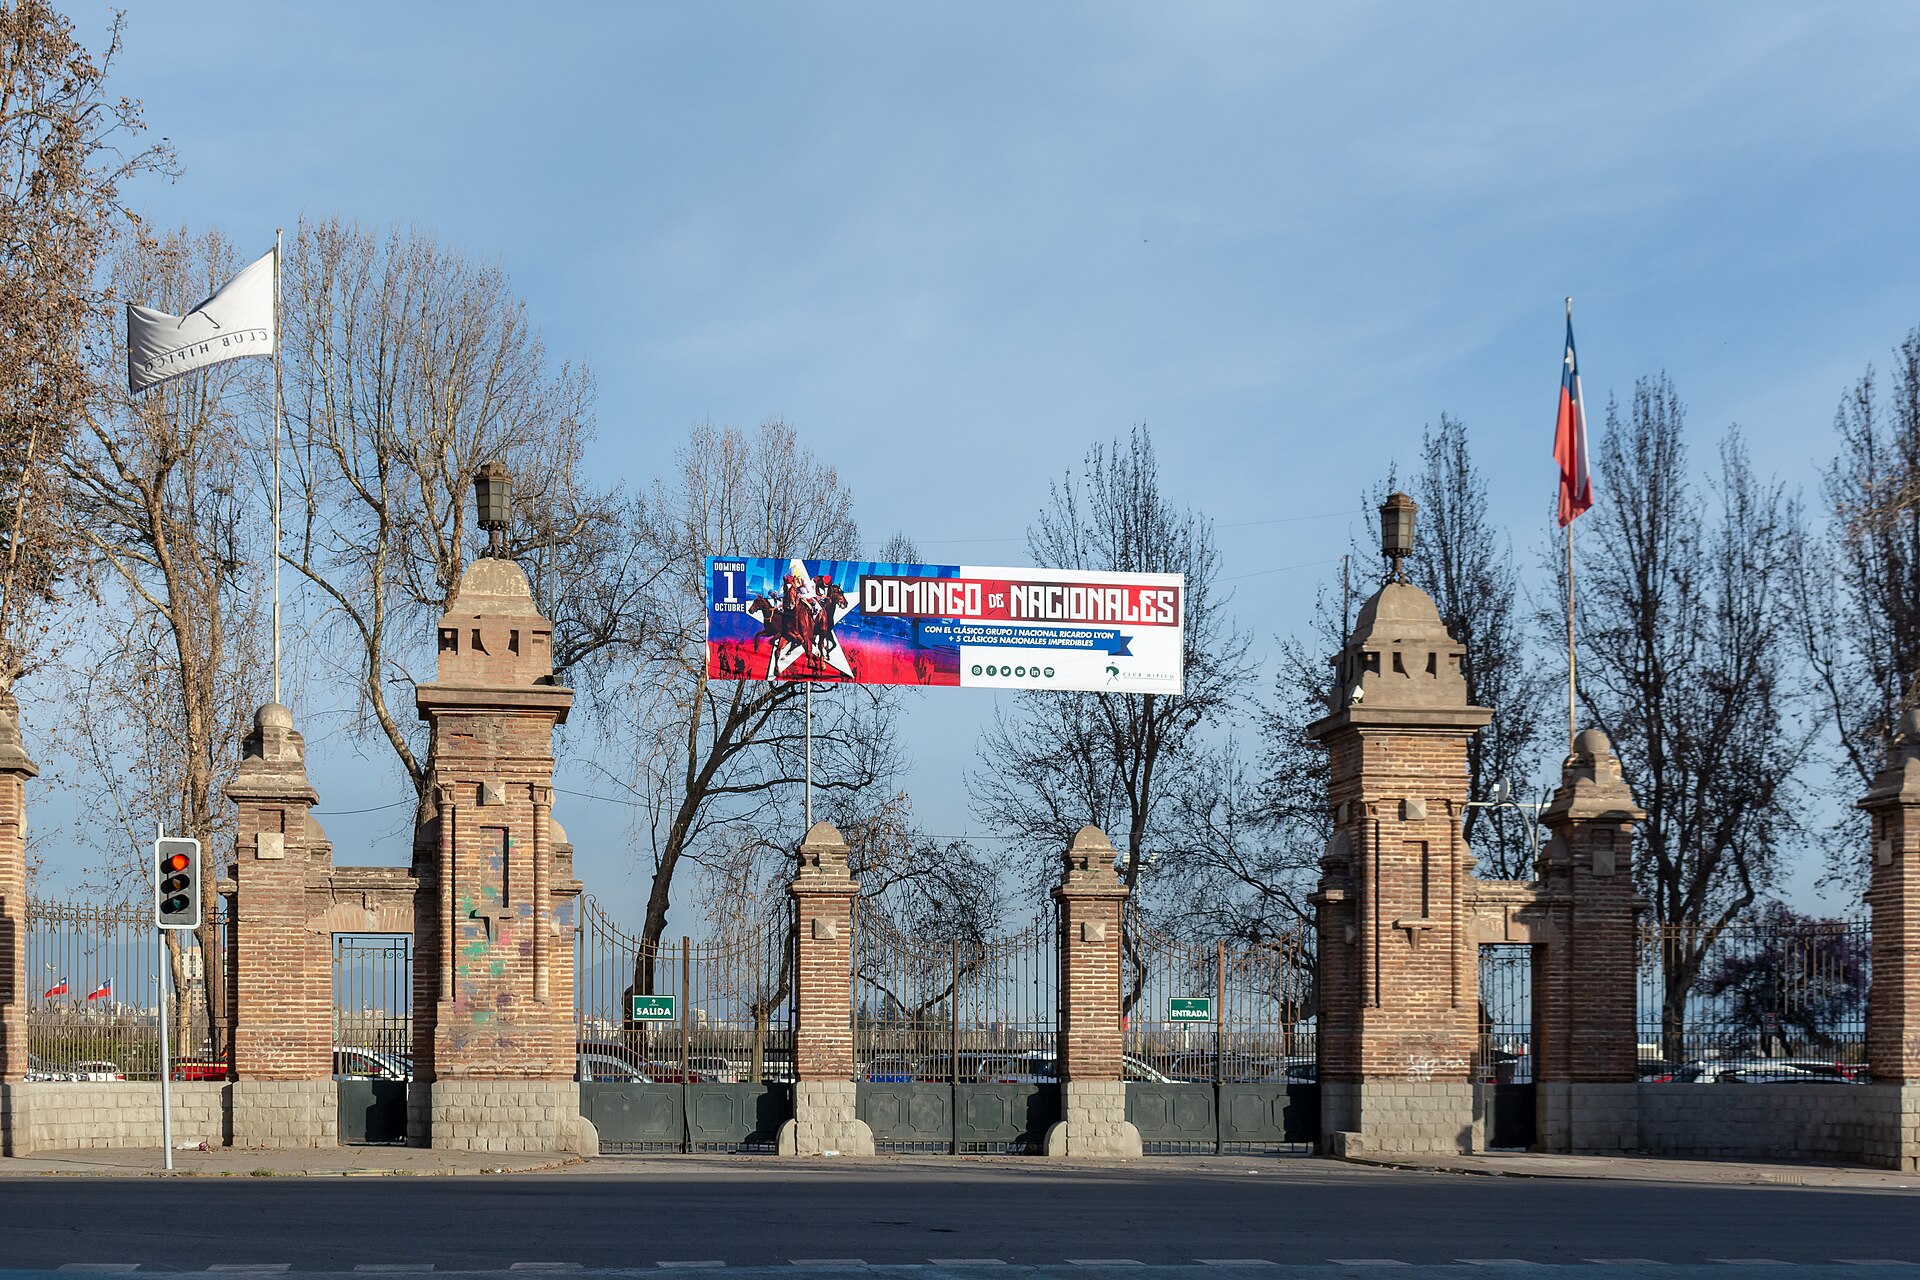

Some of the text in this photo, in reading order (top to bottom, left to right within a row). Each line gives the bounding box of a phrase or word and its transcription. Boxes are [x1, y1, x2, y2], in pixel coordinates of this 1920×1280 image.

[714, 562, 745, 572] DOMINGO
[723, 571, 738, 603] 1
[714, 602, 745, 612] OCTUBRE
[865, 579, 1174, 624] DOMINGO DE NACIONALES
[924, 626, 942, 634] CON
[953, 625, 984, 635] CLÁSICO
[985, 628, 1013, 636] GRUPO
[1018, 629, 1058, 638] NACIONAL
[1059, 630, 1092, 639] RICARDO
[1093, 632, 1114, 640] LYON
[962, 635, 998, 644] CLÁSICOS
[999, 636, 1047, 645] NACIONALES
[1048, 638, 1094, 647] IMPERDIBLES
[636, 1007, 671, 1015] SALIDA
